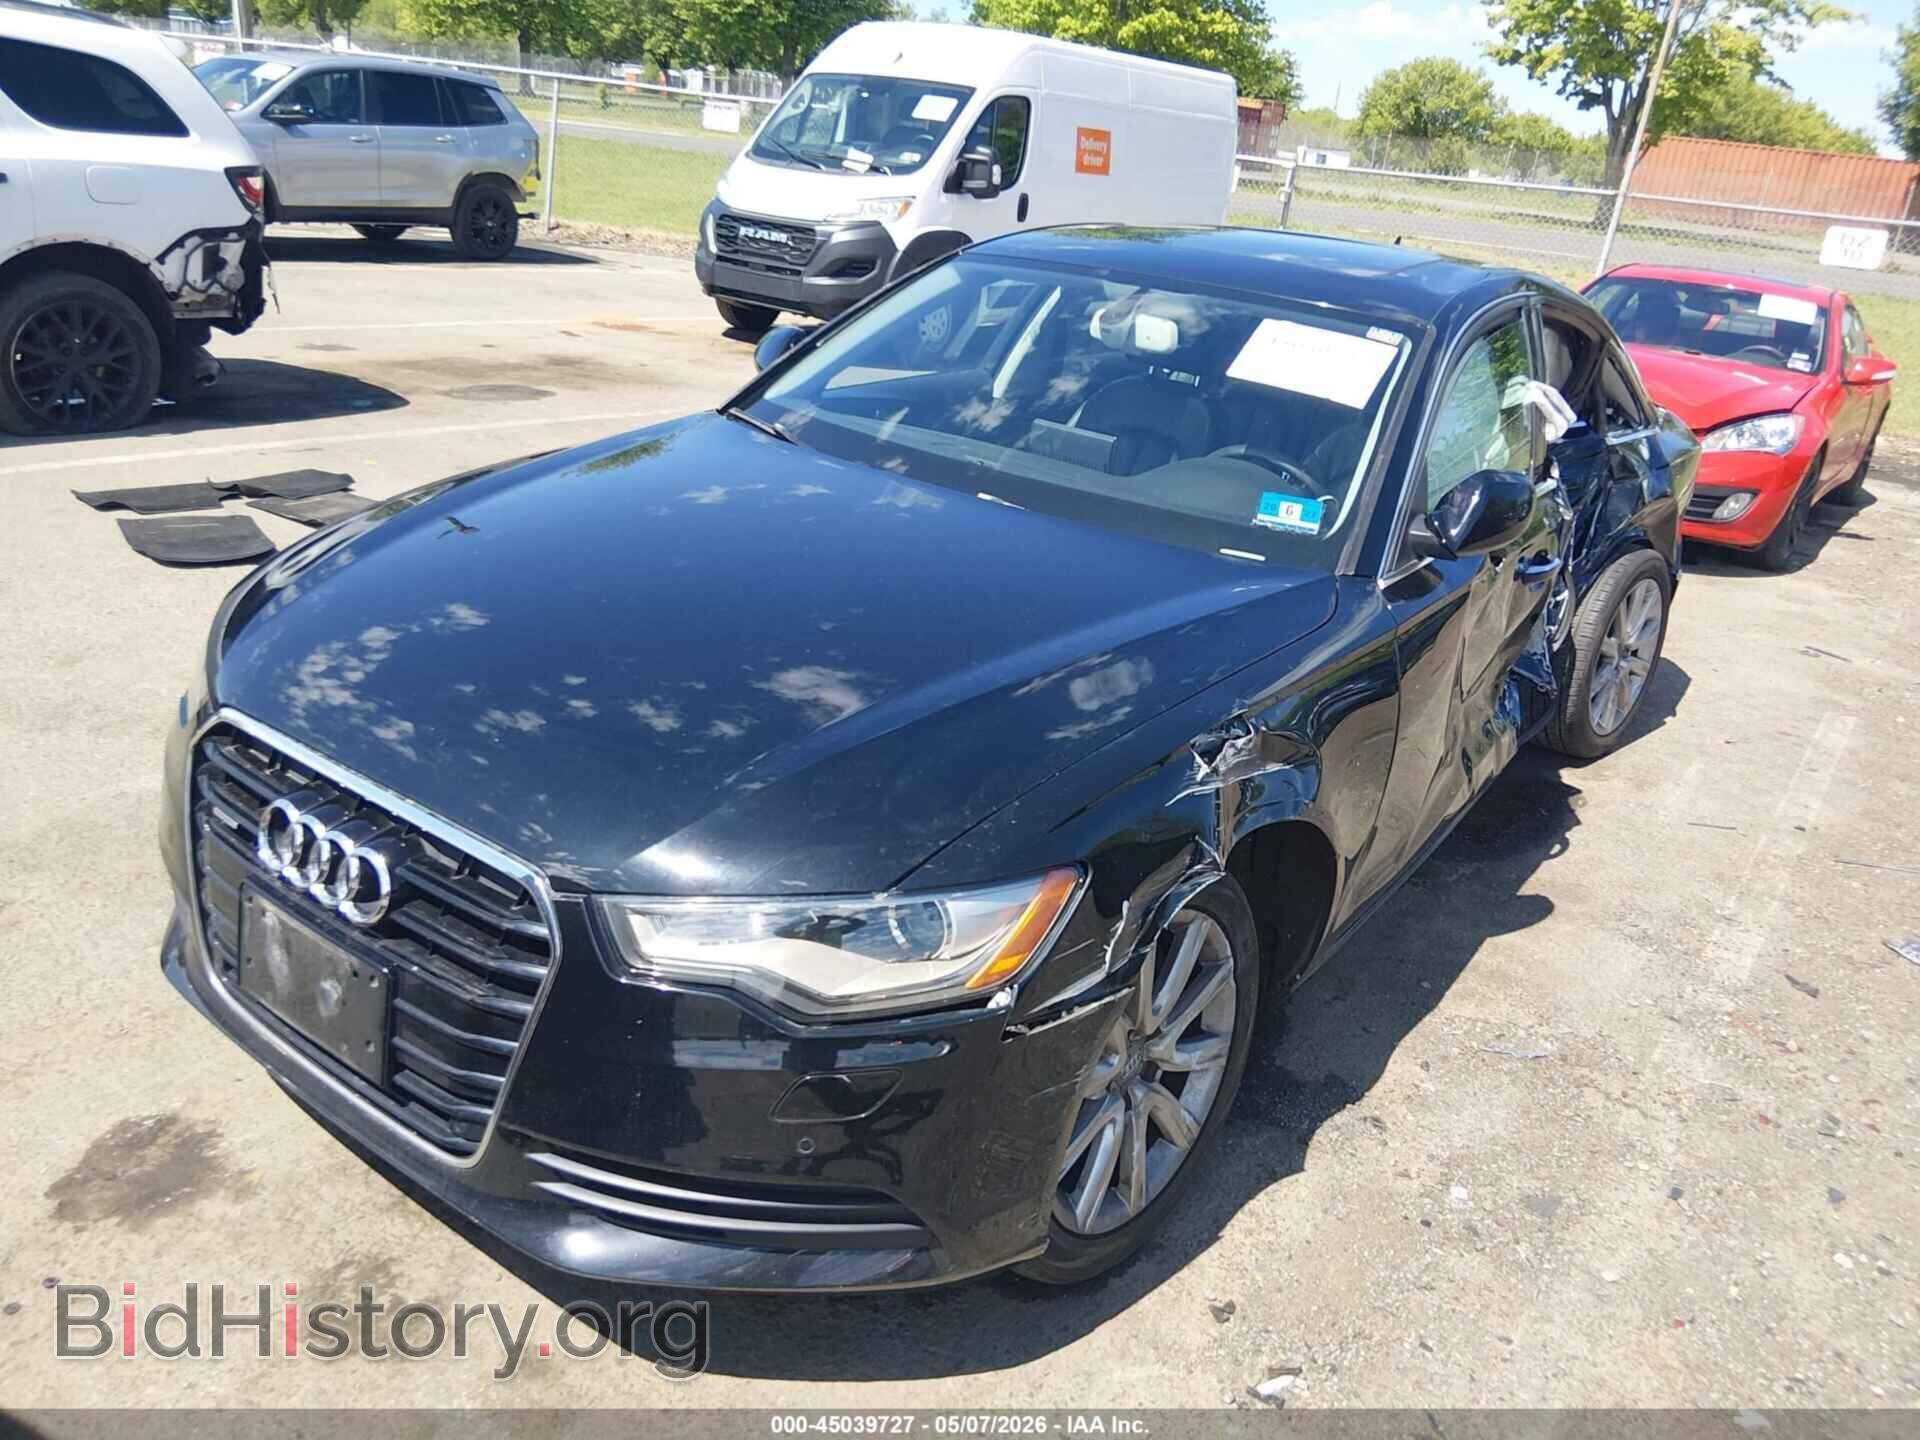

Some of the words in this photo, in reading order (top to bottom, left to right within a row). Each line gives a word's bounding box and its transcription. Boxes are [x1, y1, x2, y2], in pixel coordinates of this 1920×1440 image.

[1080, 136, 1107, 154] Delivery
[1083, 153, 1104, 167] driver
[740, 226, 788, 243] RAM
[1285, 504, 1295, 516] 6
